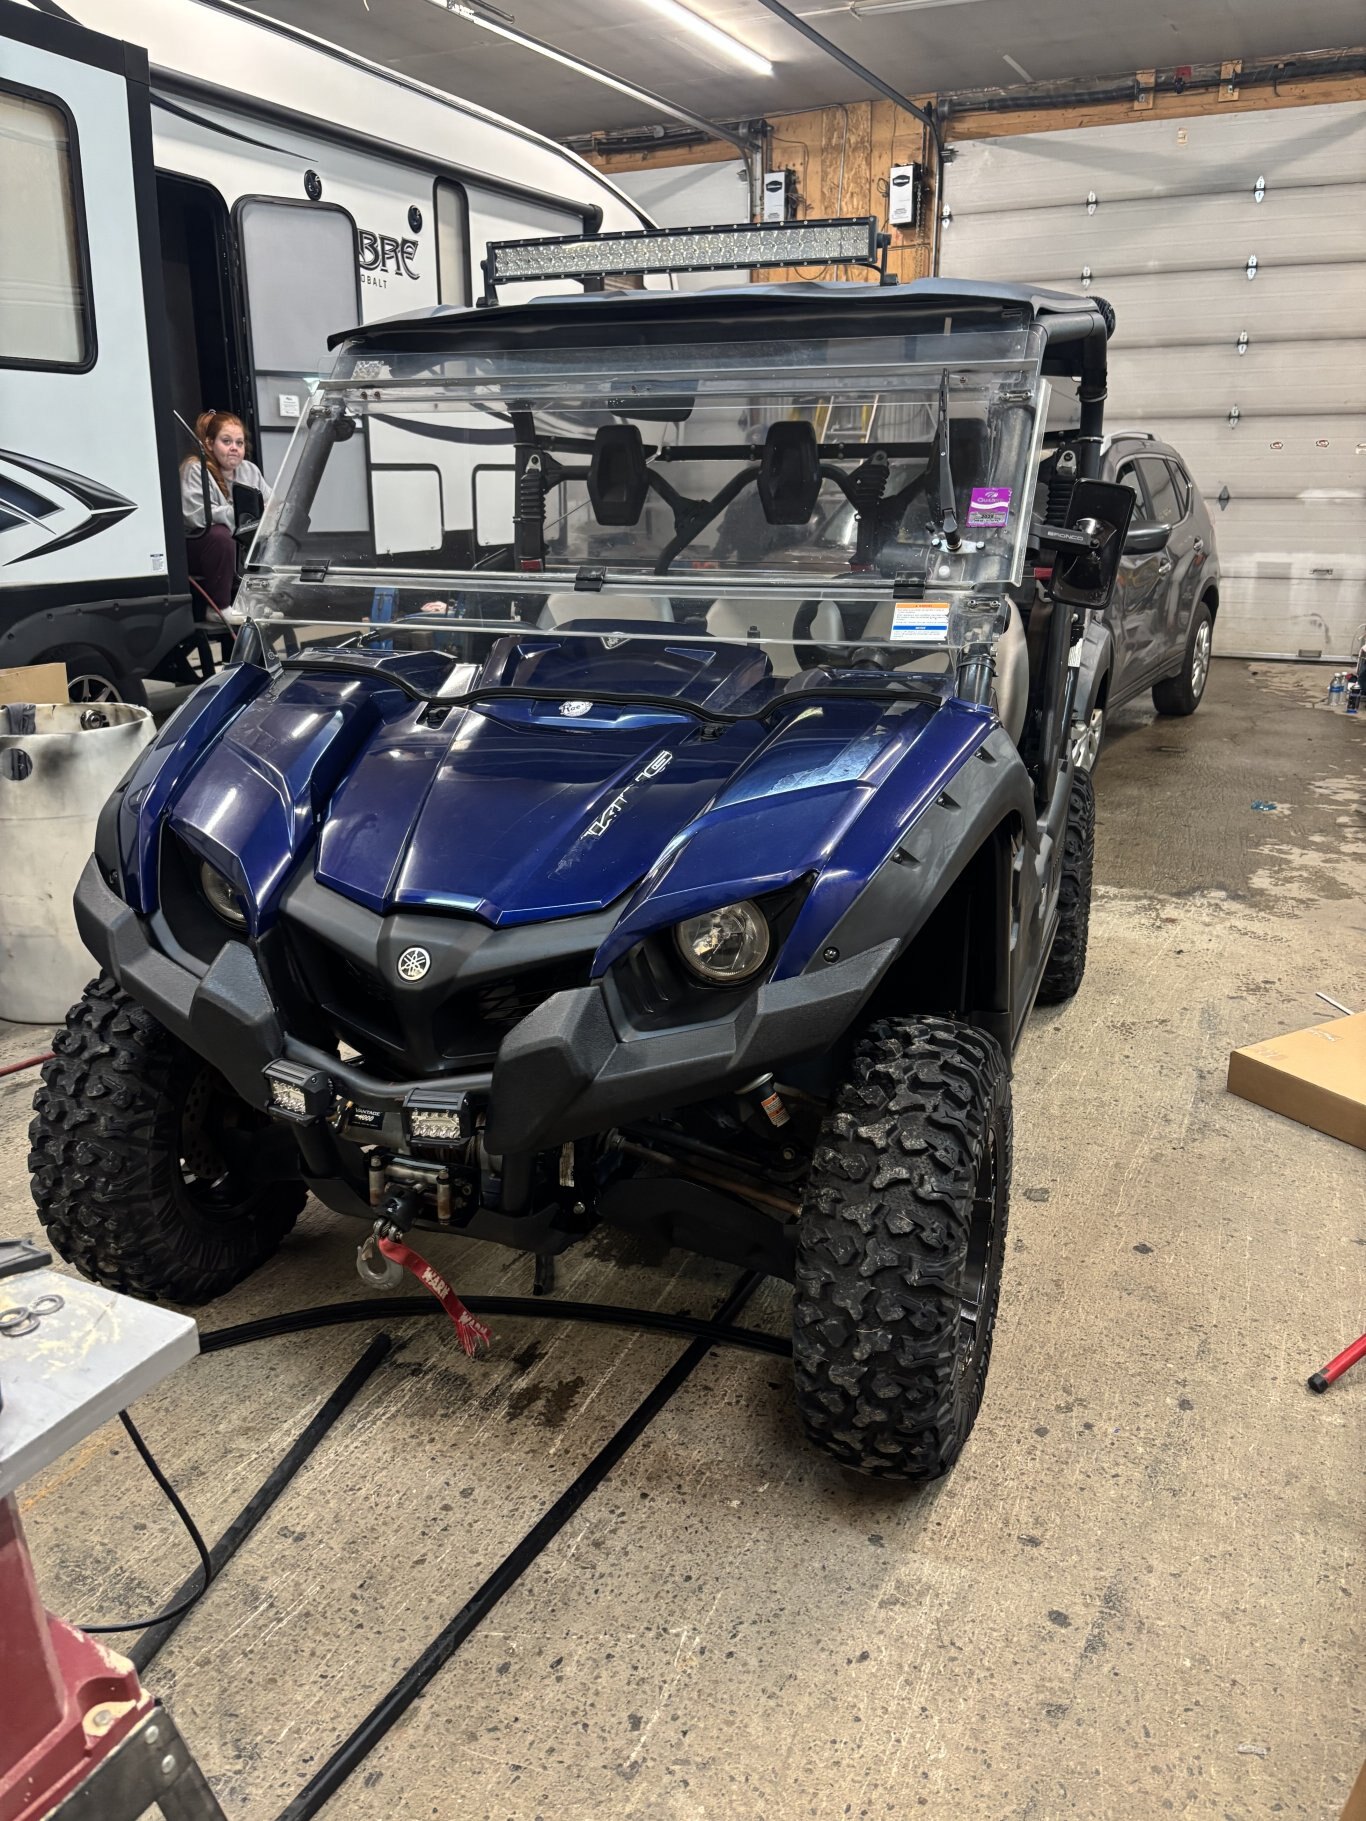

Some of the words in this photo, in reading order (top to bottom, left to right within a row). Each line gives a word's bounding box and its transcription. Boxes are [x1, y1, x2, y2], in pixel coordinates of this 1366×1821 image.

[1047, 531, 1084, 541] BRONCO
[355, 1107, 381, 1117] VANTAGE
[422, 1266, 451, 1300] WARN
